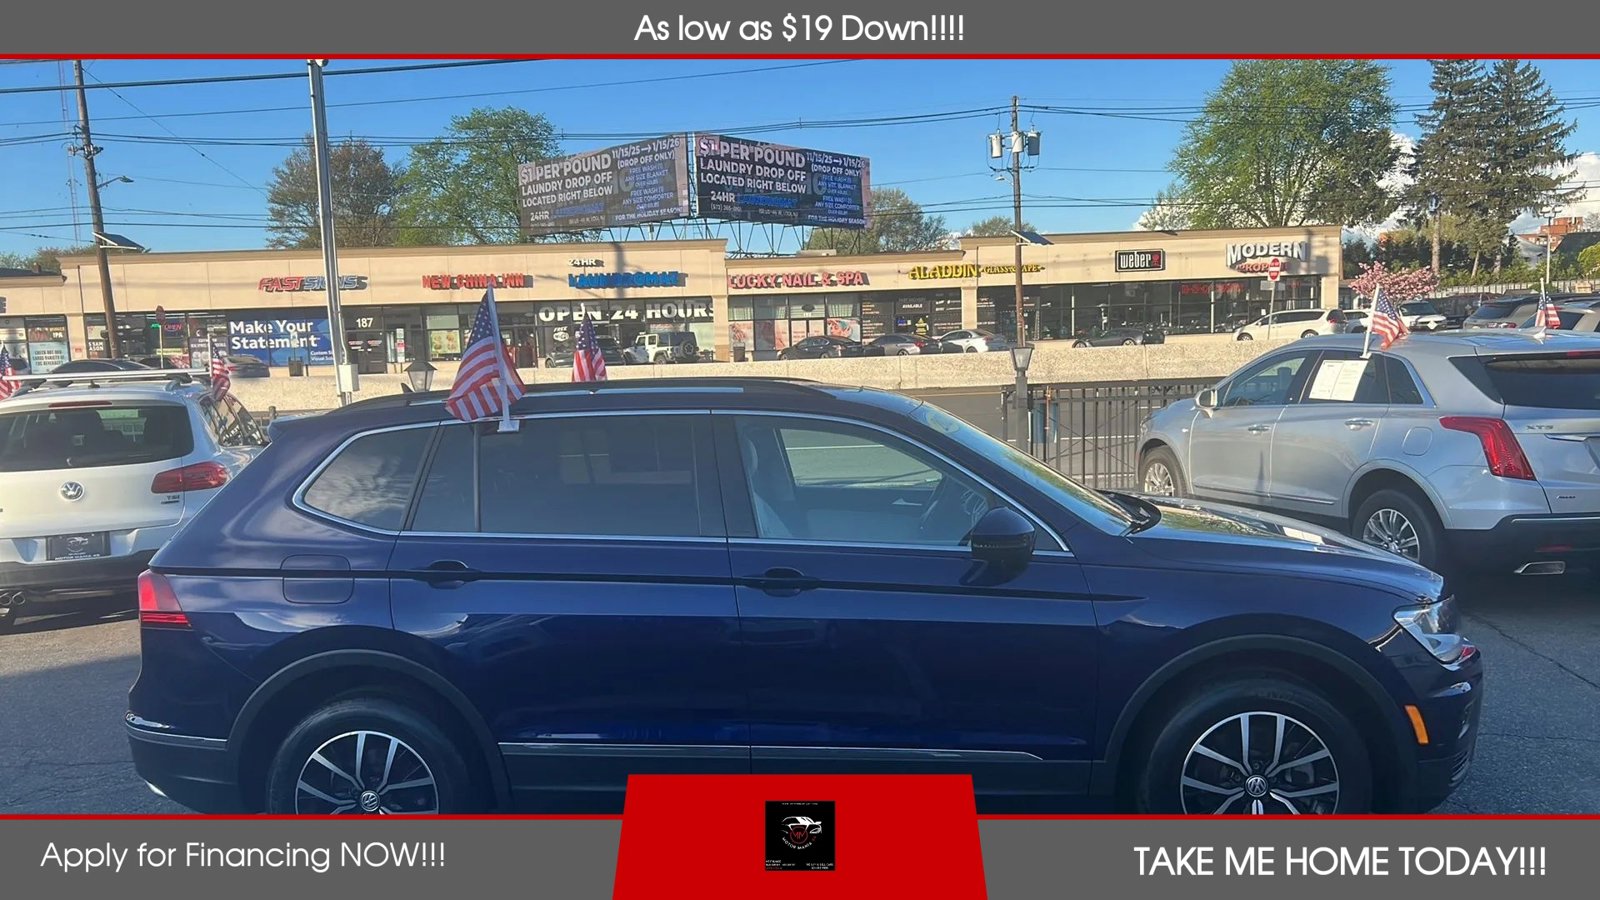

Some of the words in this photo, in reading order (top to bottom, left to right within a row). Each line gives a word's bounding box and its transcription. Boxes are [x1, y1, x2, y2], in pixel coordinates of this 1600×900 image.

[612, 145, 641, 159] 11/15/25
[652, 138, 680, 153] 1/15/26
[720, 141, 750, 161] PER
[754, 147, 806, 168] POUND
[537, 164, 560, 181] PER
[563, 153, 612, 176] POUND
[639, 154, 654, 165] OFF
[700, 158, 753, 175] LAUNDRY
[756, 165, 785, 179] DROP
[787, 170, 807, 182] OFF
[522, 180, 563, 196] LAUNDRY
[565, 175, 592, 189] DROP
[594, 171, 613, 185] OFF
[700, 173, 745, 187] LOCATED
[747, 178, 774, 191] RIGHT
[776, 182, 807, 194] BELOW
[522, 194, 556, 208] LOCATED
[558, 190, 582, 203] RIGHT
[583, 185, 613, 199] BELOW
[710, 190, 736, 203] 24HR
[1119, 250, 1153, 269] weber
[1227, 242, 1305, 266] MODERN
[422, 274, 451, 289] NEW
[457, 273, 498, 289] CHINA
[502, 272, 526, 288] INN
[728, 273, 778, 289] LUCKY
[782, 272, 817, 287] NAIL
[821, 272, 832, 286] &
[836, 270, 865, 286] SPA
[908, 264, 978, 280] ALADDIN
[538, 305, 602, 322] OPEN
[611, 304, 639, 321] 24
[230, 320, 273, 335] Make
[274, 319, 314, 334] Your
[356, 318, 374, 329] 187
[230, 334, 319, 350] Statement
